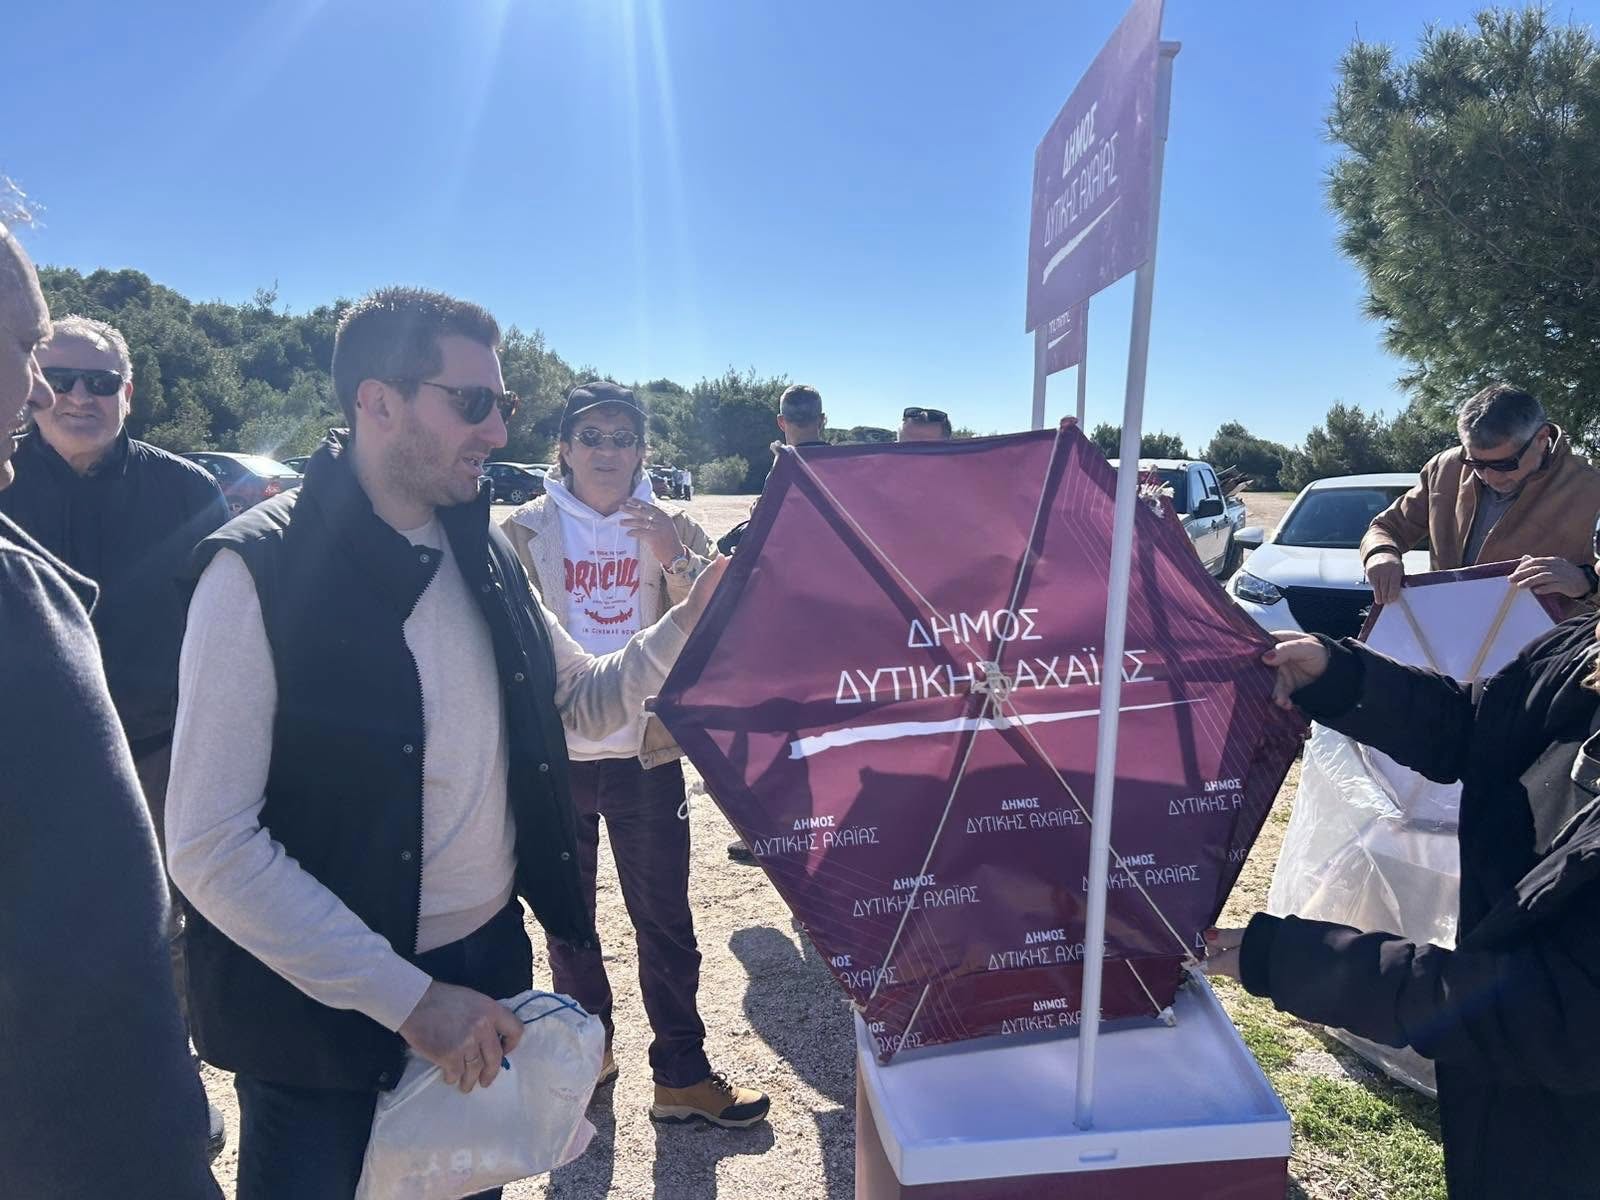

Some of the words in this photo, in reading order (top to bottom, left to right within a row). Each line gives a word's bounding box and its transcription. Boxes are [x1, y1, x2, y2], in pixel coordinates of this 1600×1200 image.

[1062, 101, 1098, 179] ΔΗΜΟΣ
[563, 557, 640, 599] DRACUL
[908, 608, 1042, 647] ΔΗΜΟΣ
[836, 661, 998, 704] ΔΥΤΙΚΗ
[1011, 647, 1154, 692] ΑΧΑΪΣ
[1204, 778, 1242, 792] ΔΗΜΟΣ
[1001, 797, 1040, 811] ΔΗΜΟΣ
[1168, 795, 1229, 815] ΔΥΤΙΚΗΣ
[793, 815, 835, 831] ΔΗΜΟΣ
[966, 813, 1026, 833] ΔΥΤΙΚΗΣ
[1030, 808, 1086, 827] ΑΧΑΪΑΣ
[753, 833, 819, 856] ΔΥΤΙΚΗΣ
[822, 826, 880, 849] ΑΧΑΪΑΣ
[893, 874, 936, 891] ΔΗΜΟΣ
[1145, 864, 1201, 887] ΑΧΑΪΑΣ
[923, 884, 981, 908] ΑΧΑΪΑΣ
[1024, 929, 1066, 945] ΔΗΜΟΣ
[987, 946, 1052, 971] ΔΥΤΙΚΗΣ
[1033, 997, 1068, 1012] ΔΗΜΟΣ
[1001, 1013, 1058, 1035] ΔΥΤΙΚΗΣ
